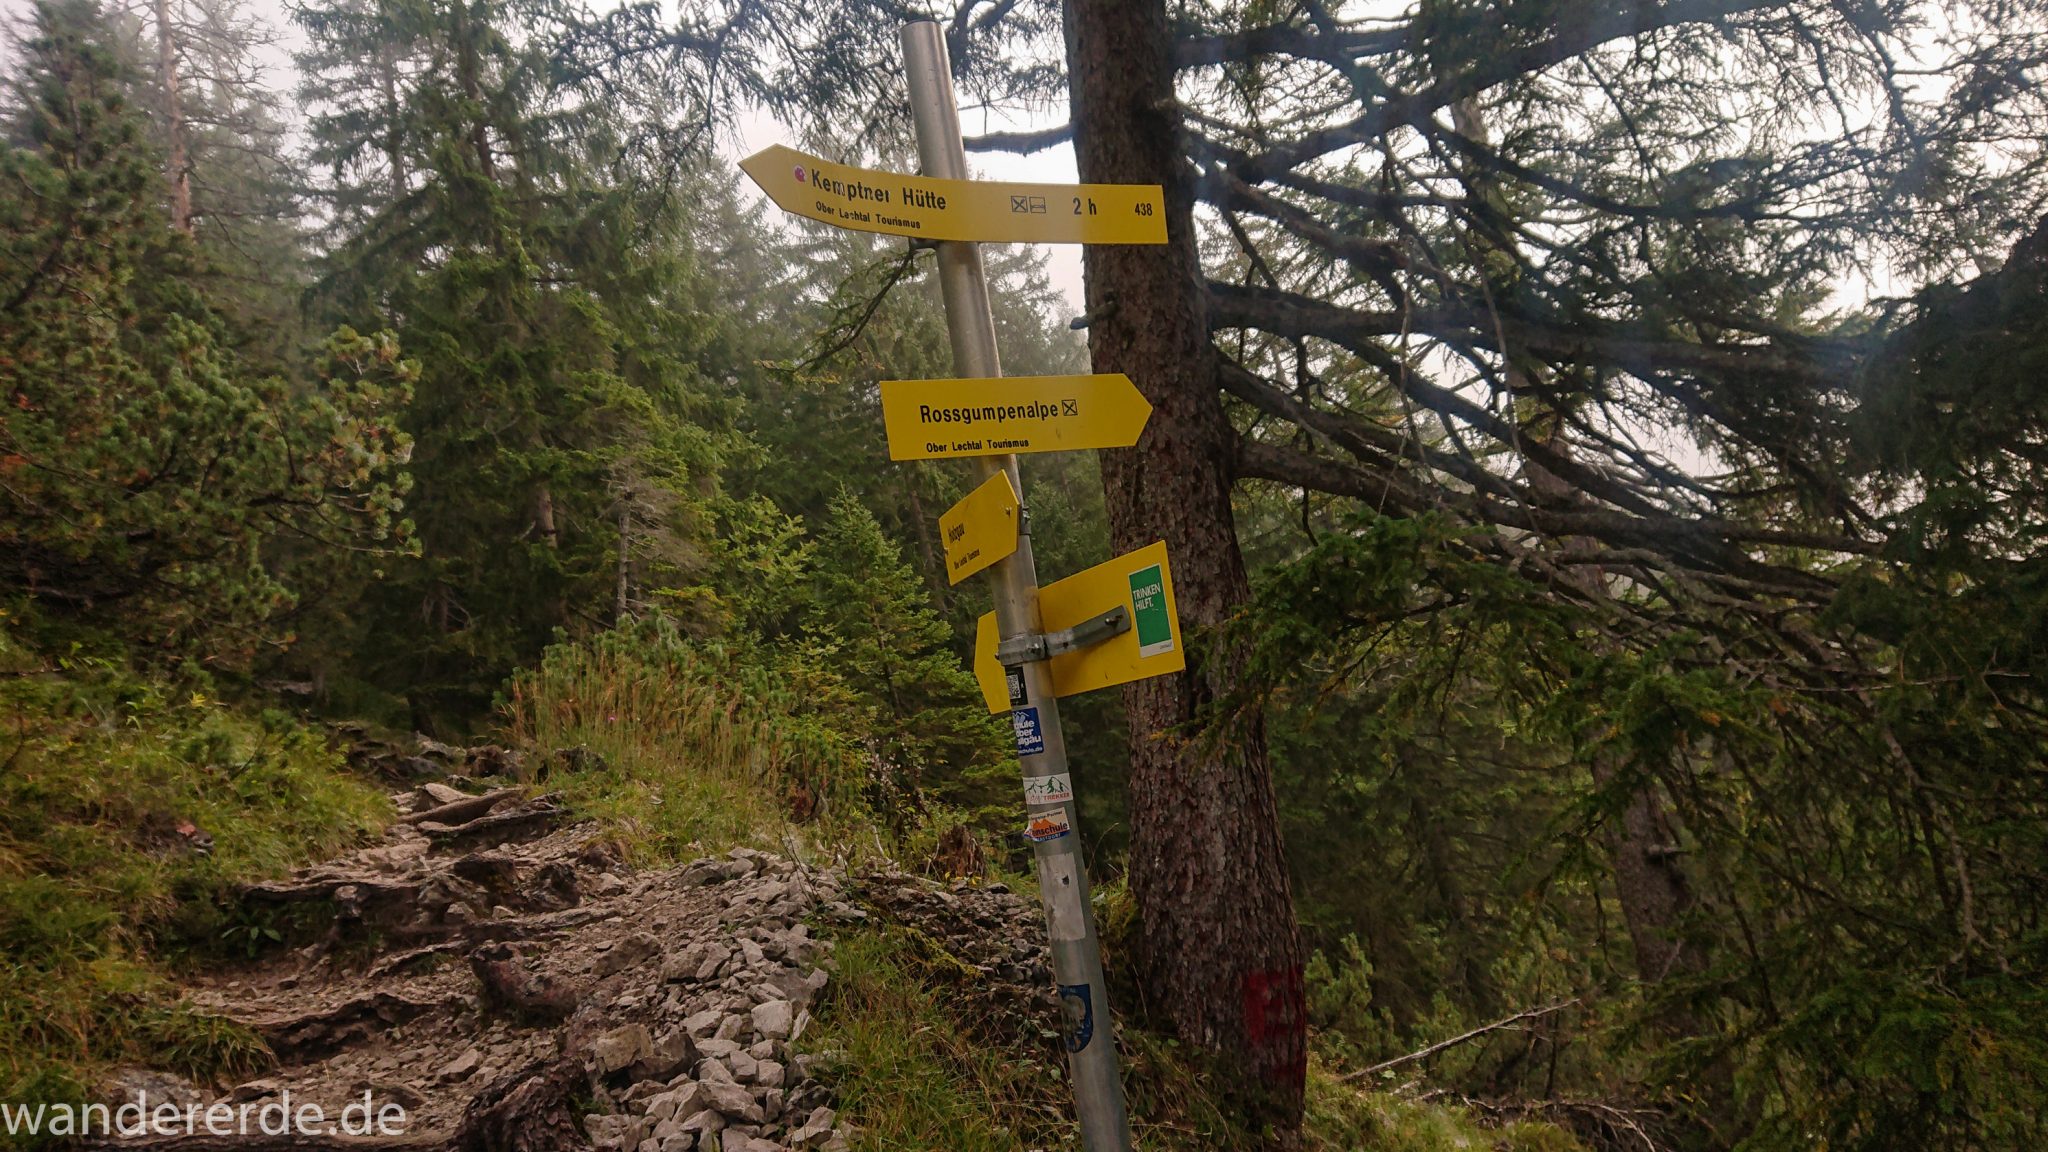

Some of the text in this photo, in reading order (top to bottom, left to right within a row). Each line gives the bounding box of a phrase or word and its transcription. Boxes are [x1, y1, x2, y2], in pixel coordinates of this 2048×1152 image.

[811, 168, 1153, 217] Kemptner Hütte 2 h 438
[816, 200, 921, 229] Ober Lechtal Tourismus
[920, 400, 1058, 424] Rossgumpenalpe
[926, 438, 1029, 453] Ober Lechtal Tourismus
[1132, 582, 1161, 601] TRINKEN
[1135, 597, 1154, 612] HILFT.
